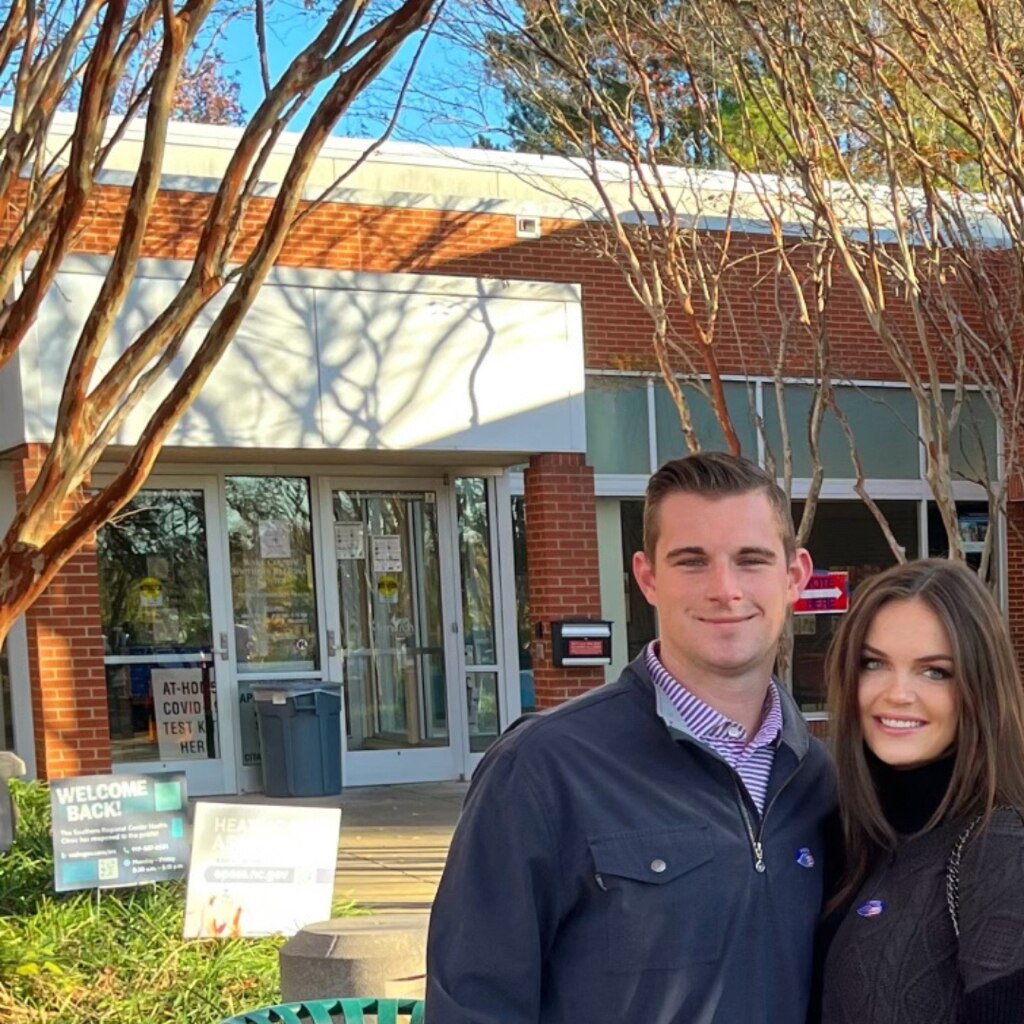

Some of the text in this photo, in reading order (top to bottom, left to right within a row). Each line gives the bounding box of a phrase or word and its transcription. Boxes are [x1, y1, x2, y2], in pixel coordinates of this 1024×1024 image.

[163, 721, 192, 735] TEST
[56, 780, 148, 804] WELCOME
[67, 801, 122, 822] BACK!
